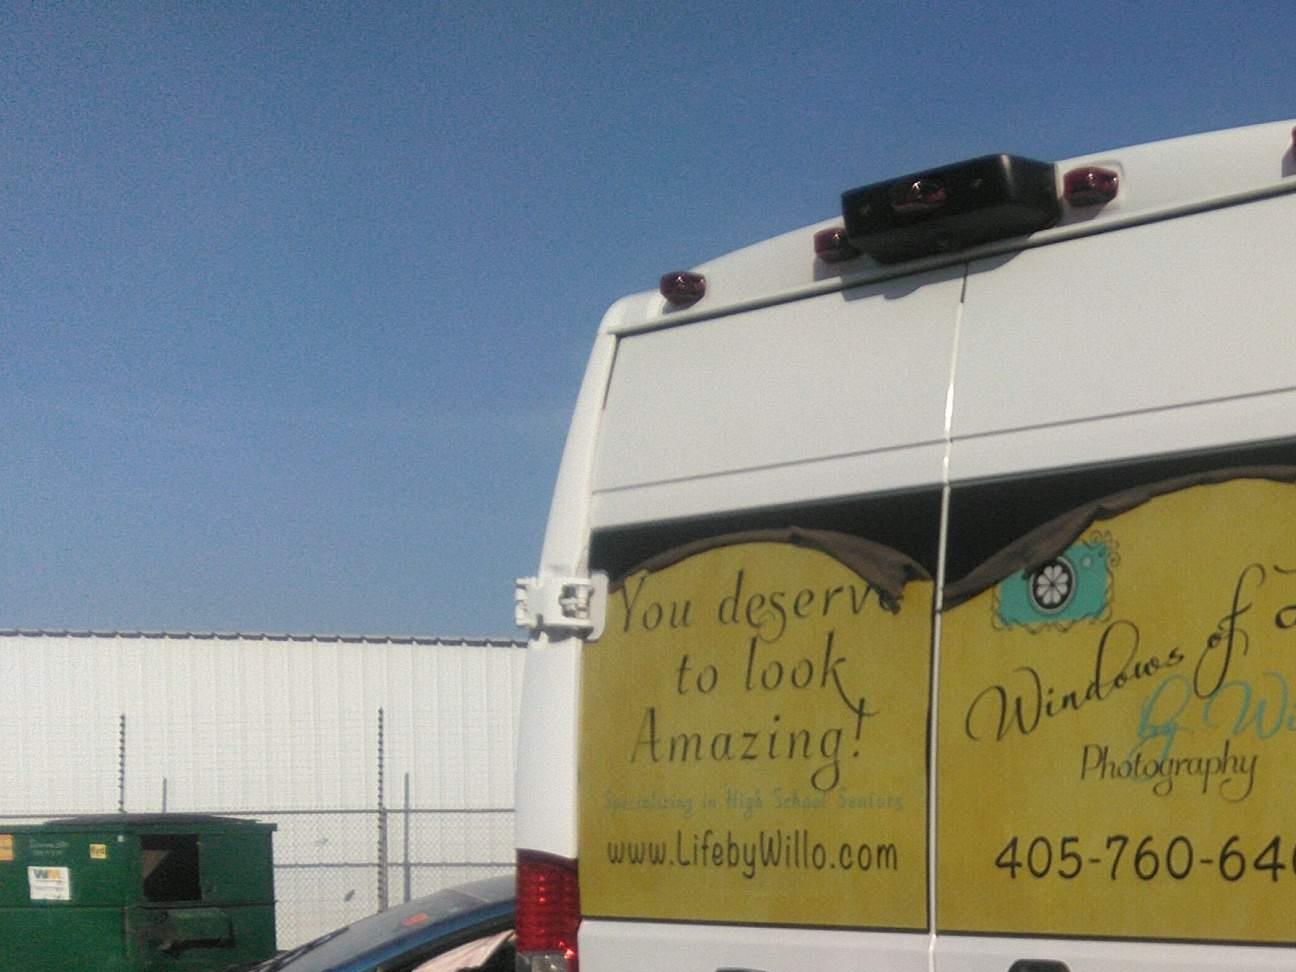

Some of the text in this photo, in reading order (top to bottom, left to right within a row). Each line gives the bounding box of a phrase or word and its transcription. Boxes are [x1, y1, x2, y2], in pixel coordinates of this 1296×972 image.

[621, 570, 690, 633] You
[677, 630, 879, 718] to look
[965, 620, 1185, 742] Windows
[1194, 563, 1266, 699] of
[630, 697, 866, 791] Amazing!
[1127, 674, 1194, 783] by
[725, 788, 763, 820] High
[773, 787, 827, 809] School
[1081, 739, 1257, 803] Photography
[607, 829, 898, 879] www.LifebyWillo.com
